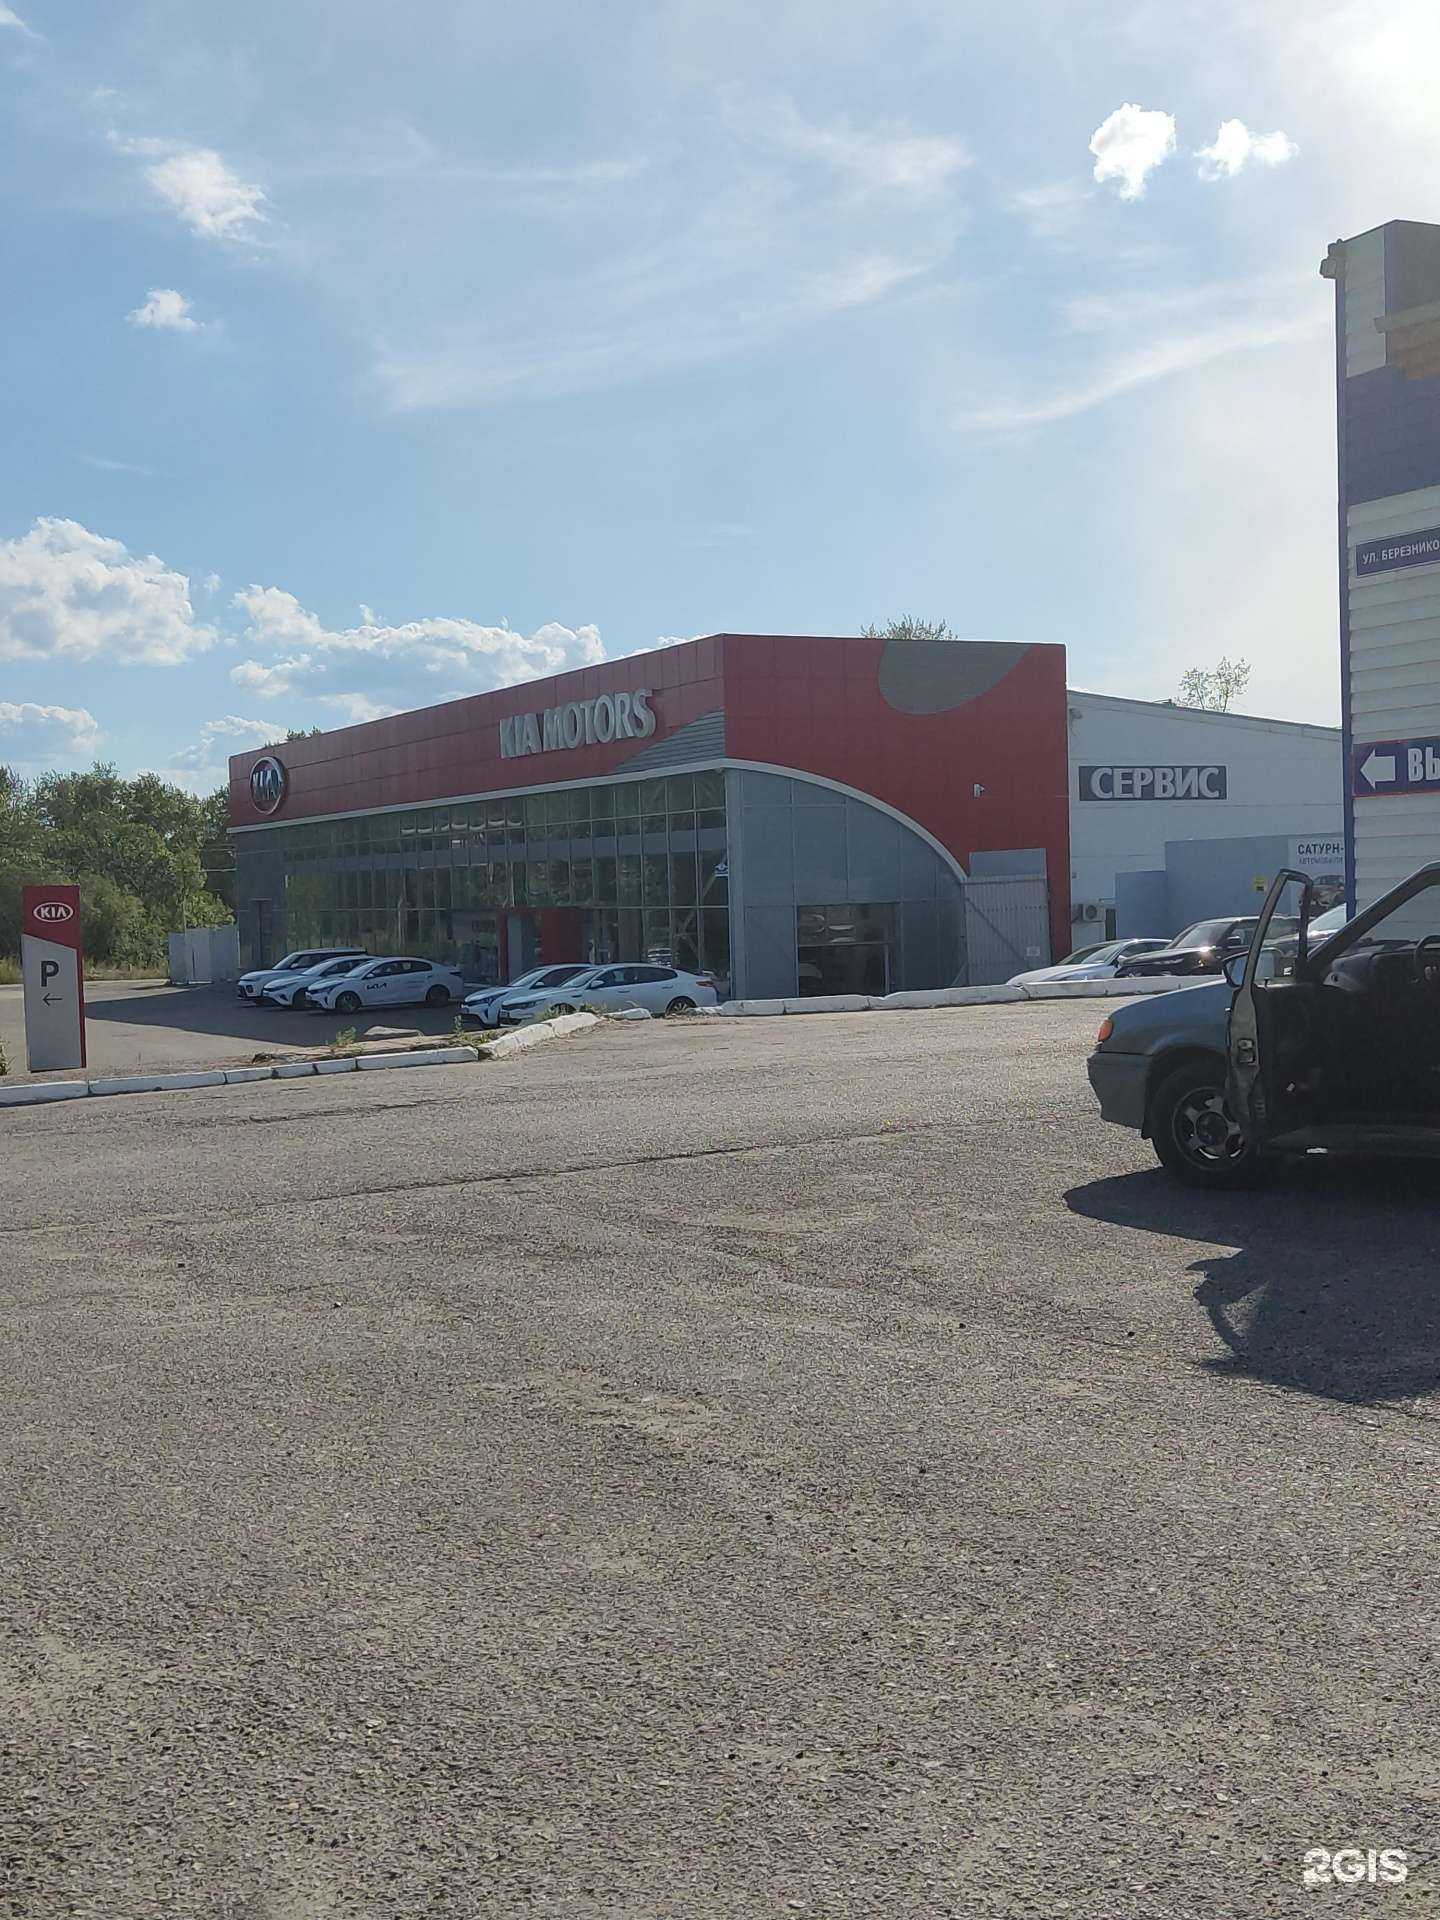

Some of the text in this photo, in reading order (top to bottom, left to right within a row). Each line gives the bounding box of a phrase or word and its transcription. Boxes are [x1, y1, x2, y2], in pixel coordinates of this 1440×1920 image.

[500, 688, 656, 759] KIA MOTORS
[1091, 767, 1219, 799] СЕРВИС
[41, 960, 59, 987] P
